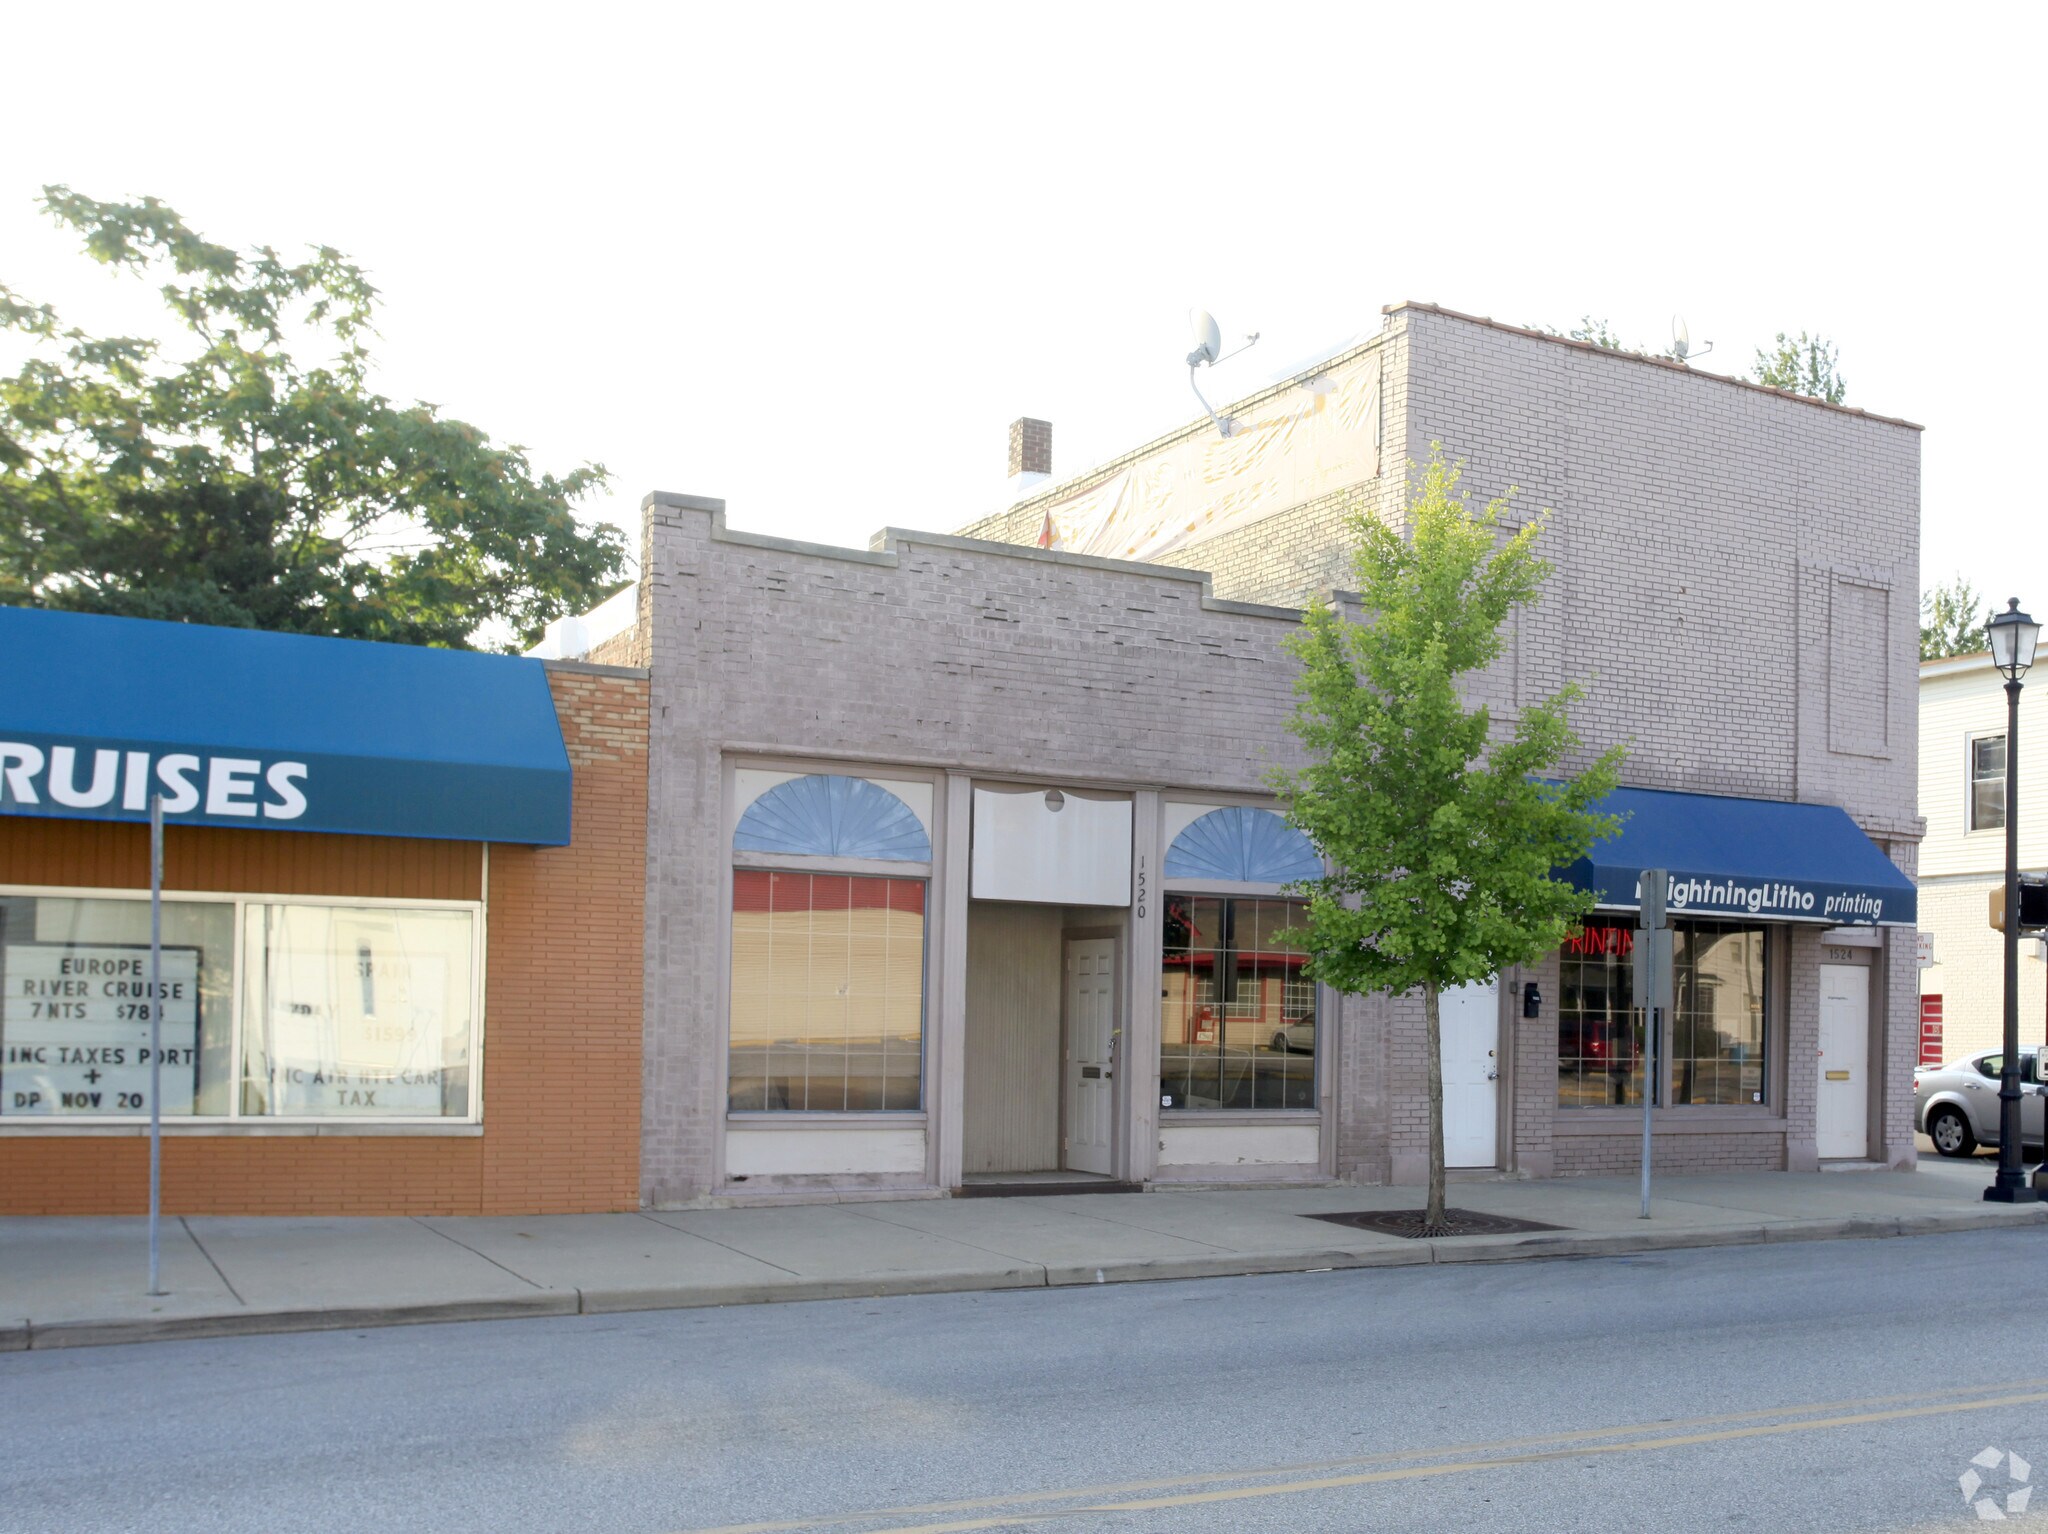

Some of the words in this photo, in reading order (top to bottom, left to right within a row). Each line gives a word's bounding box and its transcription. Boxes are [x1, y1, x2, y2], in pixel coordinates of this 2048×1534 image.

[1138, 855, 1146, 919] 1520
[1667, 876, 1815, 912] ightningLitho
[1824, 892, 1882, 919] printing
[1829, 949, 1852, 960] 1524
[61, 958, 142, 976] EUROPE
[24, 980, 89, 997] RIVER
[103, 981, 183, 999] CRUISE
[10, 1047, 46, 1063] INC
[59, 1047, 125, 1064] TAXES
[84, 1069, 101, 1085] +
[401, 1069, 439, 1085] CAR
[14, 1092, 41, 1109] DP
[62, 1092, 102, 1108] NOV
[117, 1092, 143, 1109] 20
[337, 1089, 376, 1106] TAX
